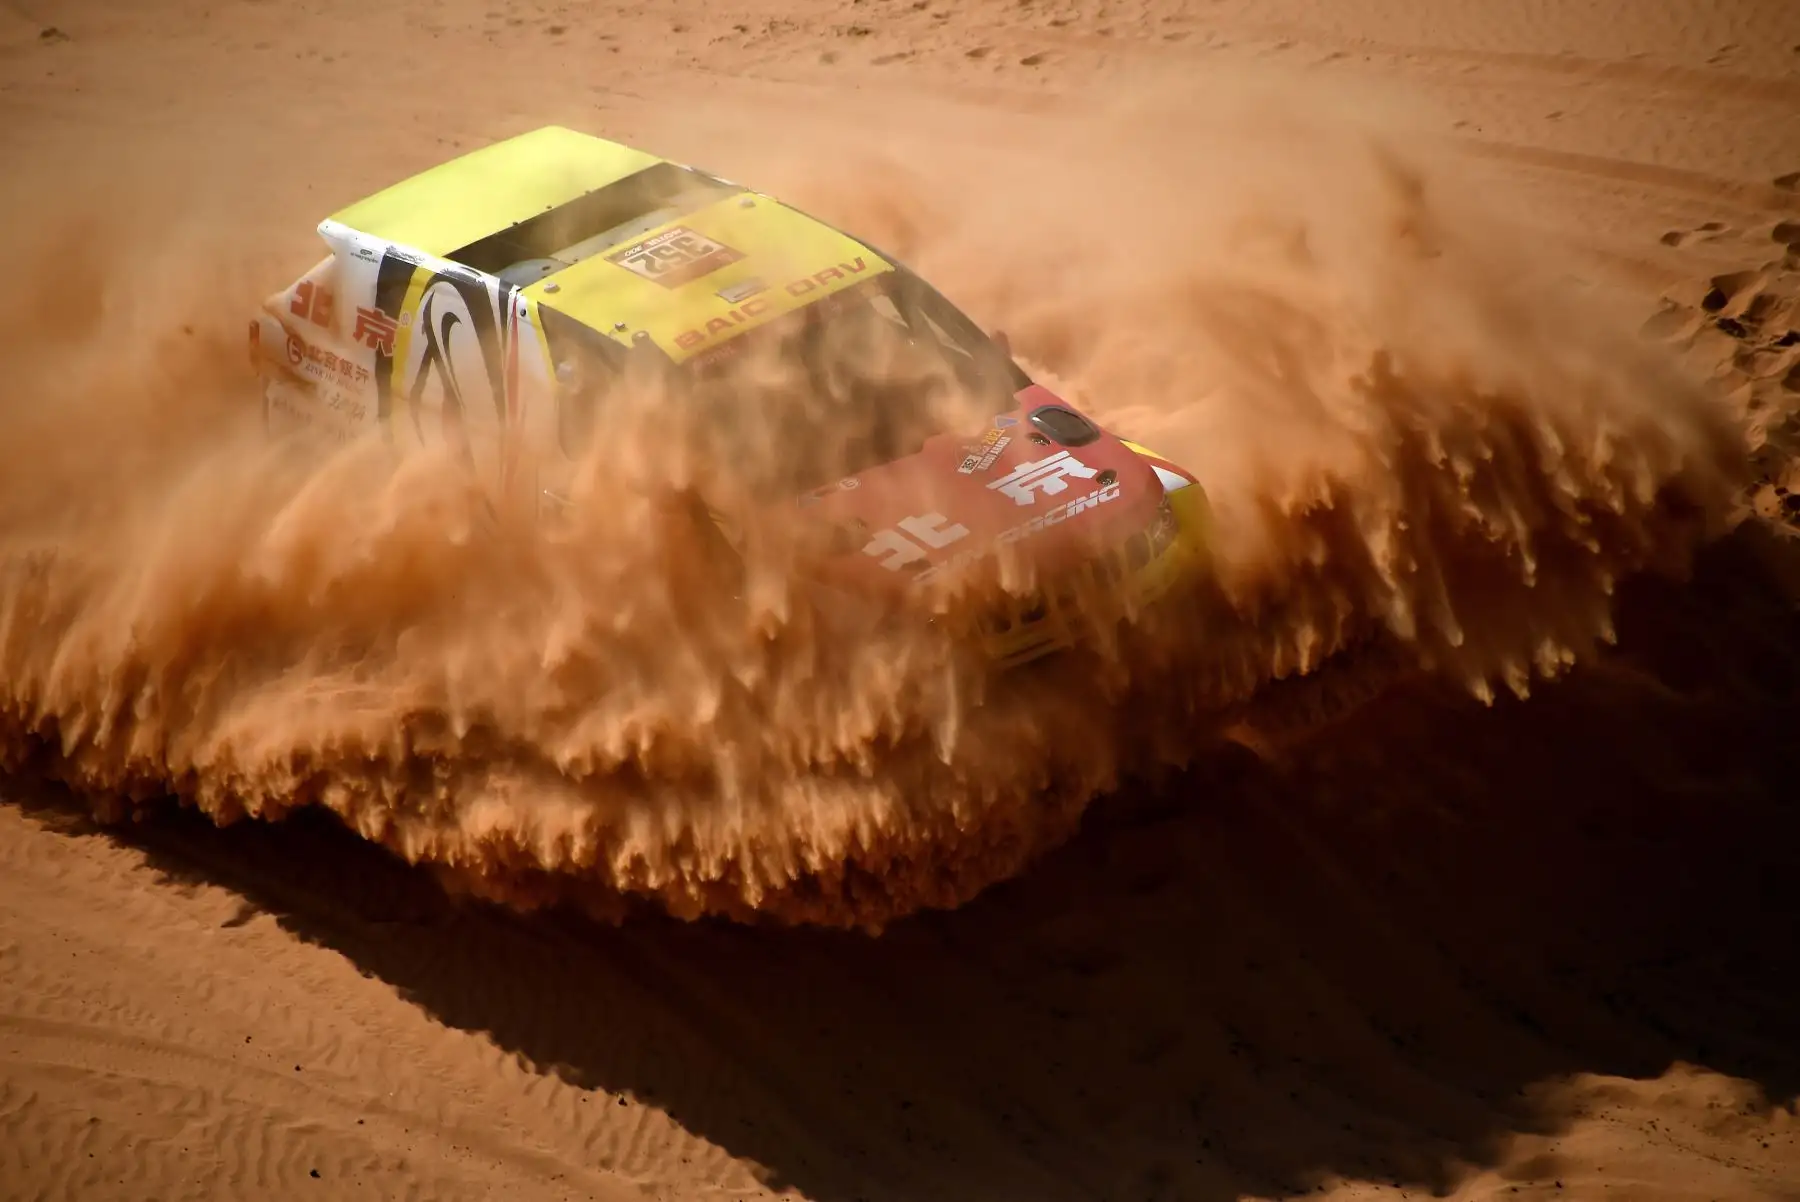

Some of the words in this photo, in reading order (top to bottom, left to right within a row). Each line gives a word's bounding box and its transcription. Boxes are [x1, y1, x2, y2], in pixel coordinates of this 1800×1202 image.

[290, 280, 400, 357] 北京
[674, 299, 768, 351] BAIC
[862, 451, 1098, 572] 北京
[997, 482, 1120, 543] RACING
